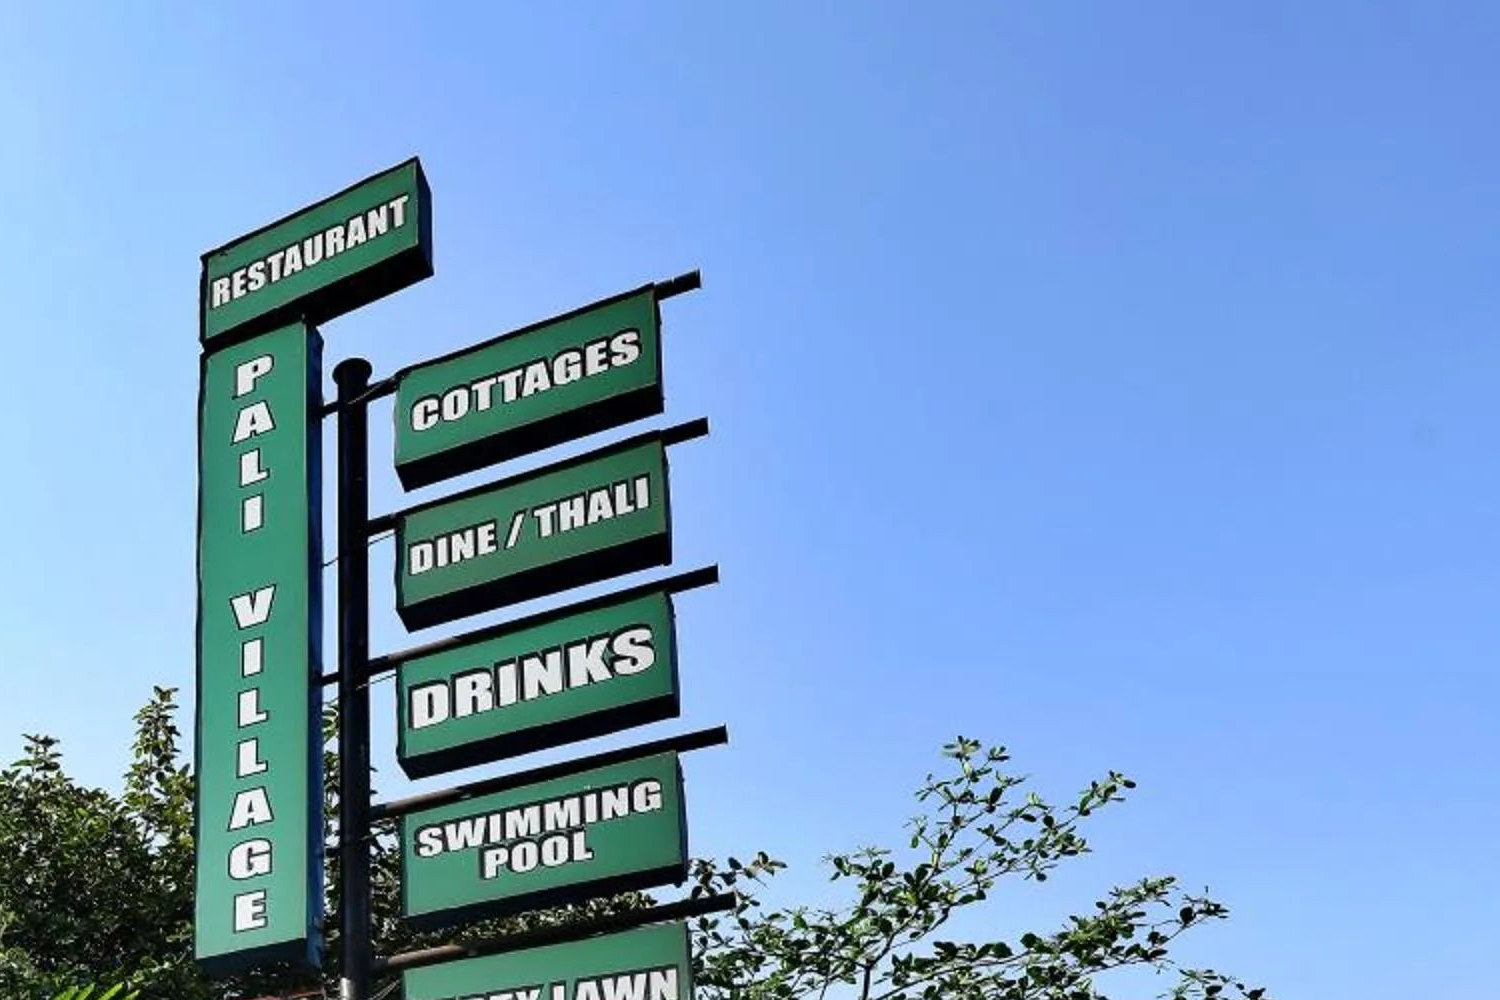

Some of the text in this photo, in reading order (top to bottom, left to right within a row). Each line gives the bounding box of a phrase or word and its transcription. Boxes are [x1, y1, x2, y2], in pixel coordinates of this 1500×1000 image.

[212, 194, 409, 309] RESTAURANT
[411, 331, 640, 432] COTTAGES
[409, 522, 498, 576] DINE
[532, 476, 650, 538] THALI
[229, 355, 275, 932] PALI VILLAGE
[411, 628, 656, 730] DRINKS
[418, 780, 663, 858] SWIMMING
[483, 831, 594, 880] POOL
